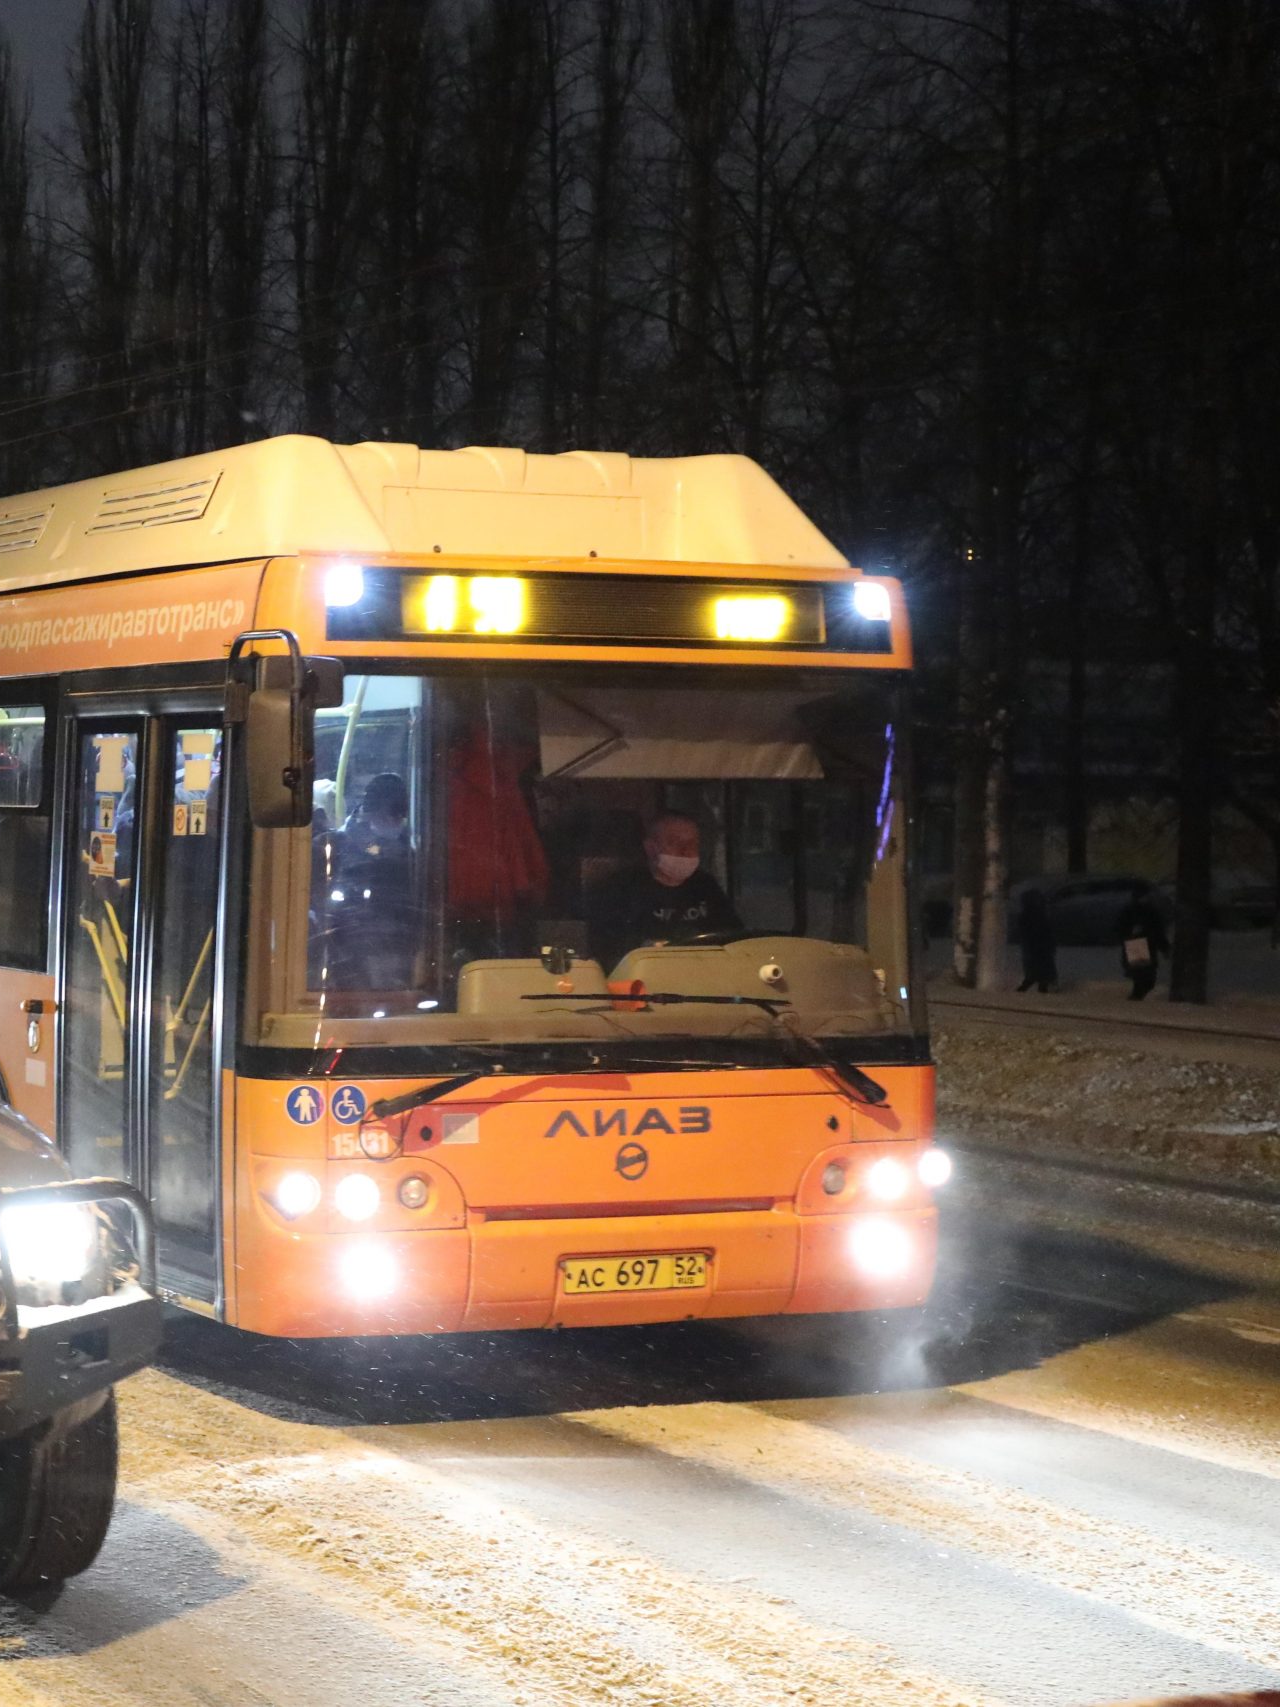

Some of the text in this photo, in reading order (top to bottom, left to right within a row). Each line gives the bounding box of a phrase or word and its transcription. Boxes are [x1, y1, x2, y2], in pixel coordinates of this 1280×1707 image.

[544, 1106, 711, 1138] ЛИАЗ
[616, 1258, 659, 1286] 697
[675, 1256, 698, 1277] 52
